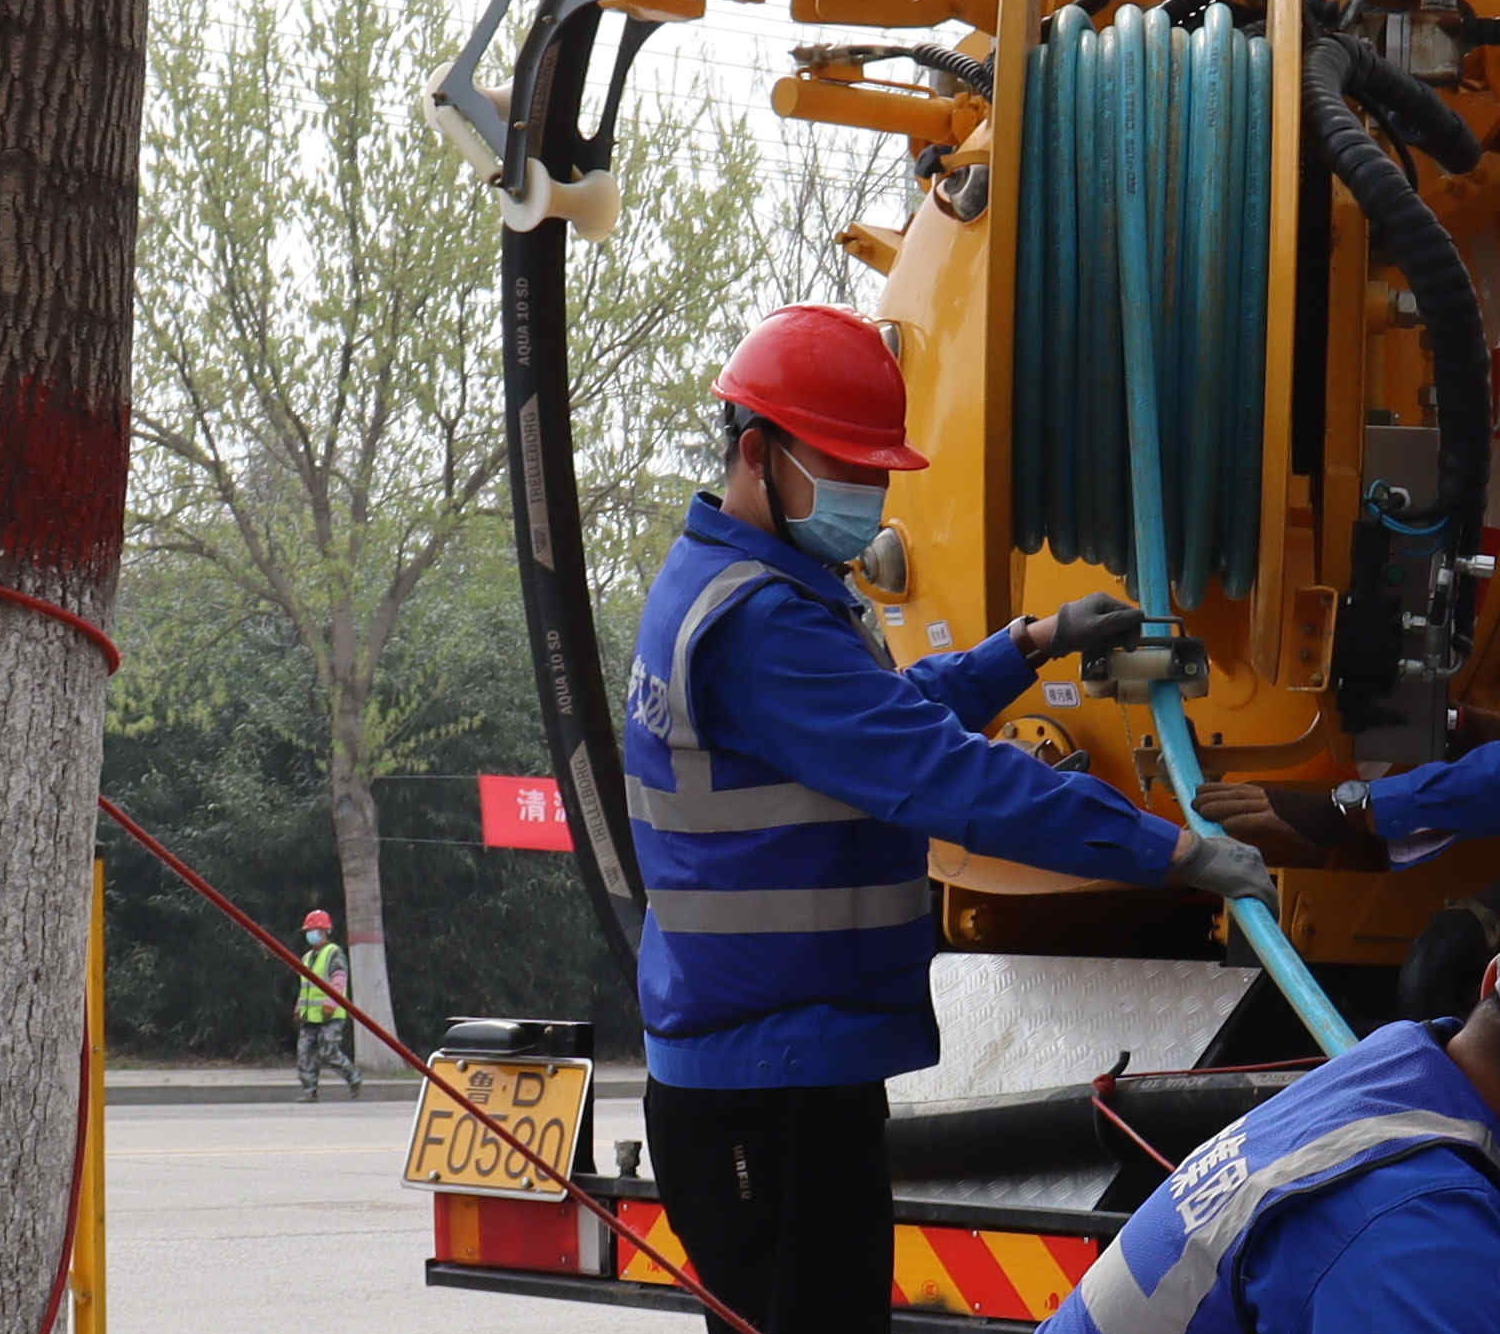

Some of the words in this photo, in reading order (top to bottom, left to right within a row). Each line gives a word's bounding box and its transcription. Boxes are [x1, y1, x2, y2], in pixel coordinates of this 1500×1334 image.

[516, 276, 530, 297] SD
[517, 300, 530, 319] 10
[518, 323, 531, 366] AQUA
[416, 1110, 565, 1181] F0580
